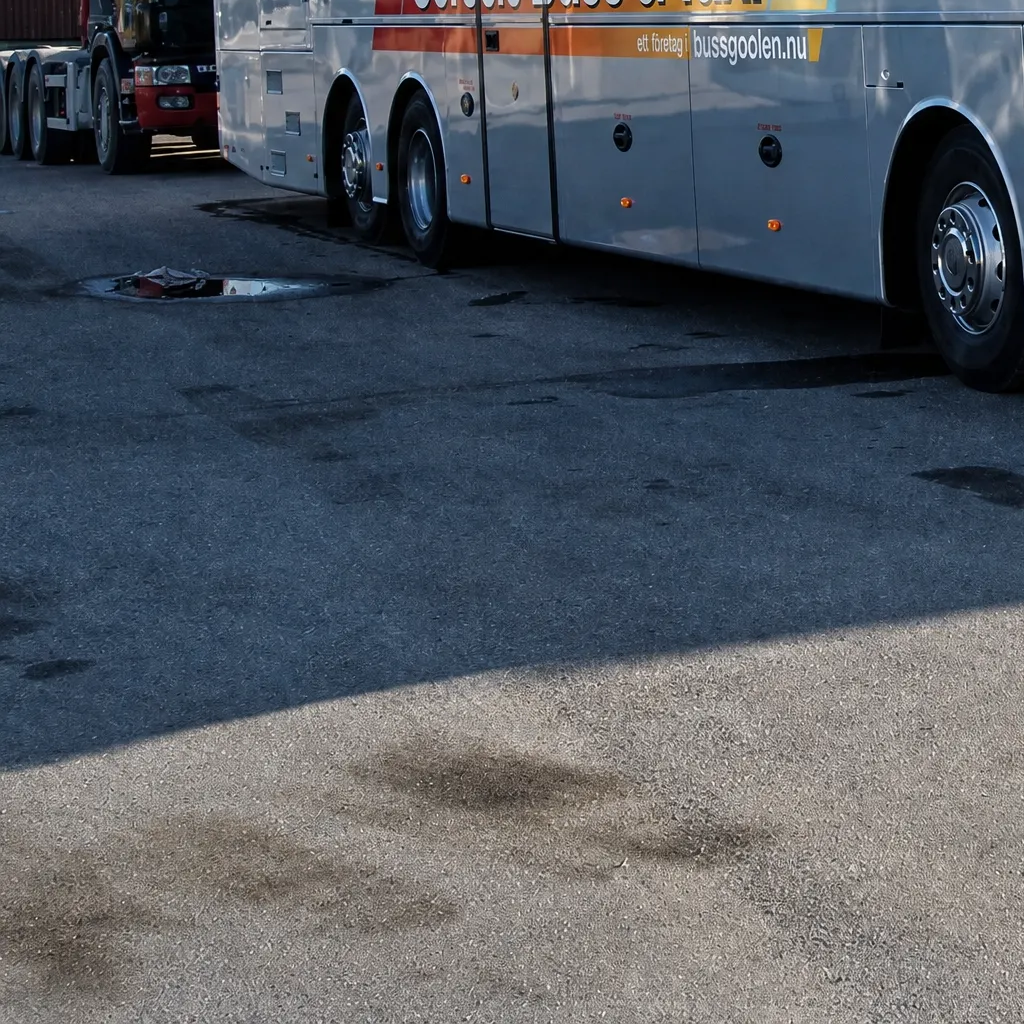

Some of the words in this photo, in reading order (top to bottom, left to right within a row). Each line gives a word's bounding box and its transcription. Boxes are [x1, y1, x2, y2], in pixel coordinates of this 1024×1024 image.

[637, 33, 650, 52] ett
[652, 32, 683, 58] företag
[685, 33, 689, 53] i
[693, 29, 807, 66] bussgoolen.nu
